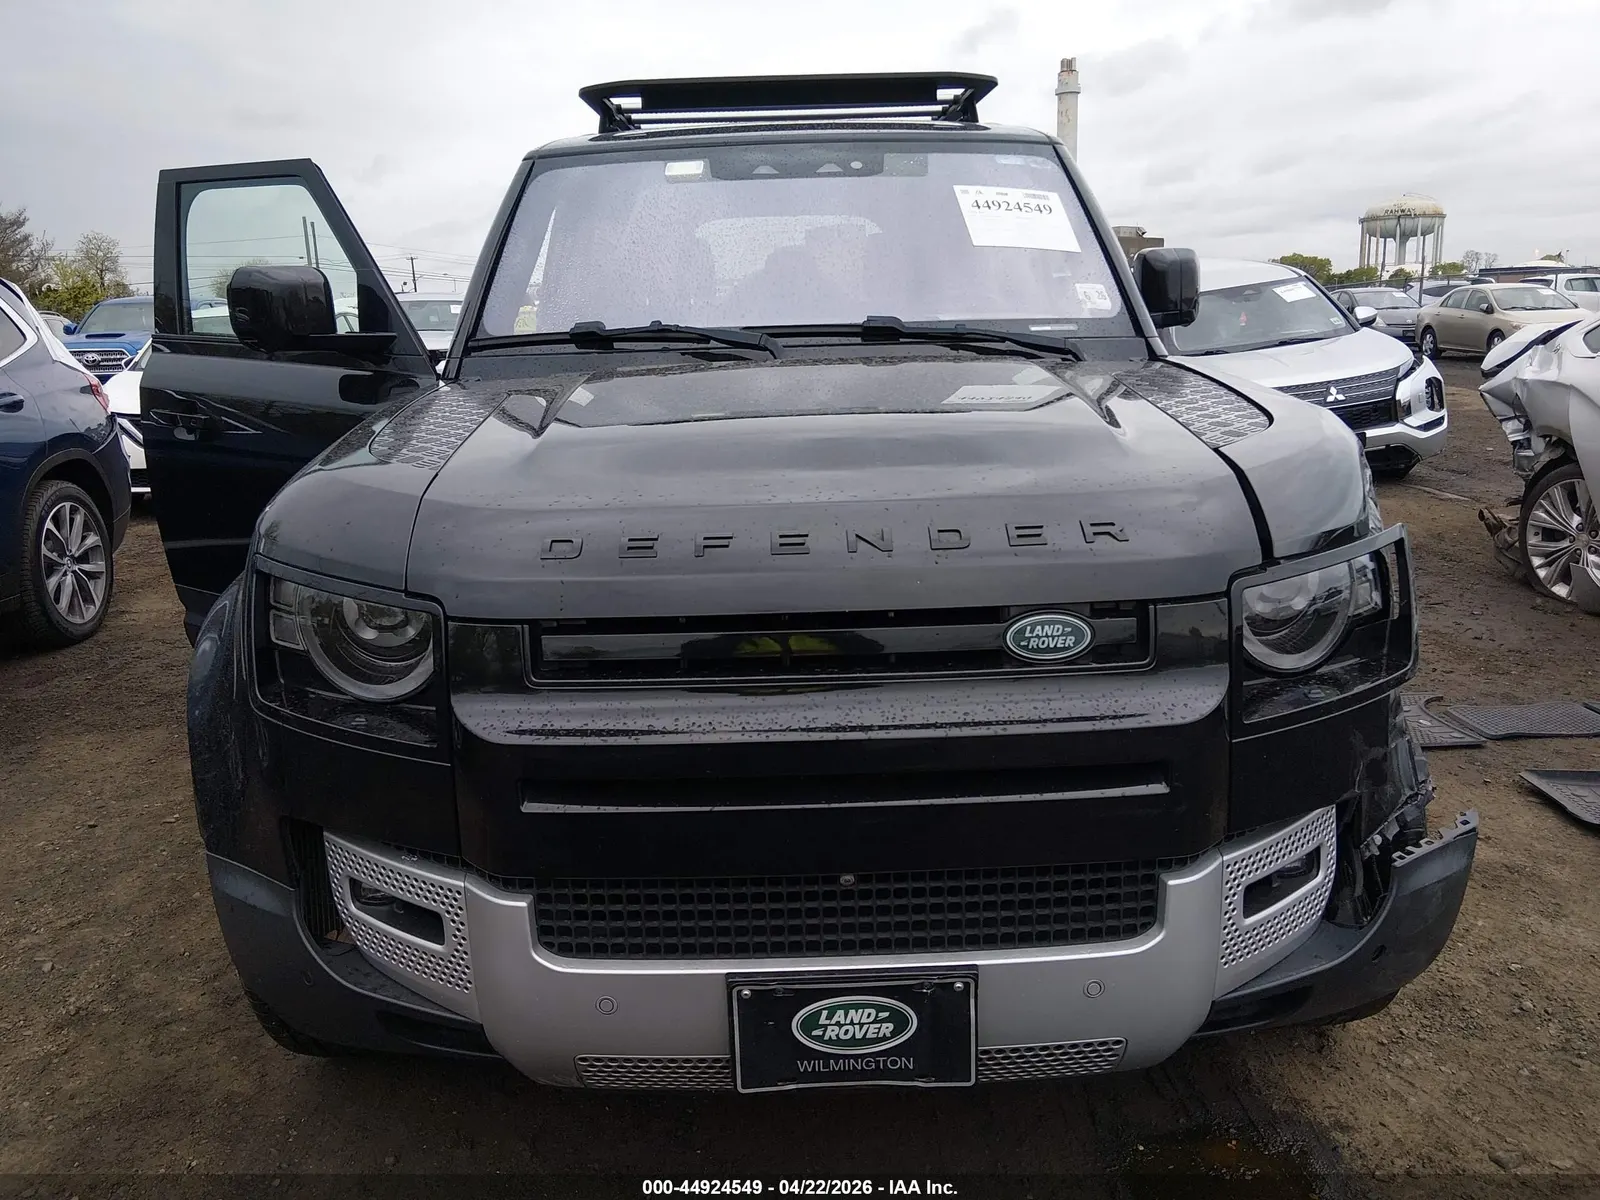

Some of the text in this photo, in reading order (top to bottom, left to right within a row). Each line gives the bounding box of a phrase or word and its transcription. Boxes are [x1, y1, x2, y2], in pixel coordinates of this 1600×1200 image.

[971, 199, 1053, 215] 44924549
[1384, 207, 1416, 215] RAHWAY
[540, 519, 1130, 561] DEFENDER
[1025, 624, 1064, 637] LAND
[1028, 636, 1076, 649] ROVER
[818, 1008, 878, 1025] LAND
[823, 1023, 894, 1040] ROVER
[797, 1056, 914, 1073] WILMINGTON
